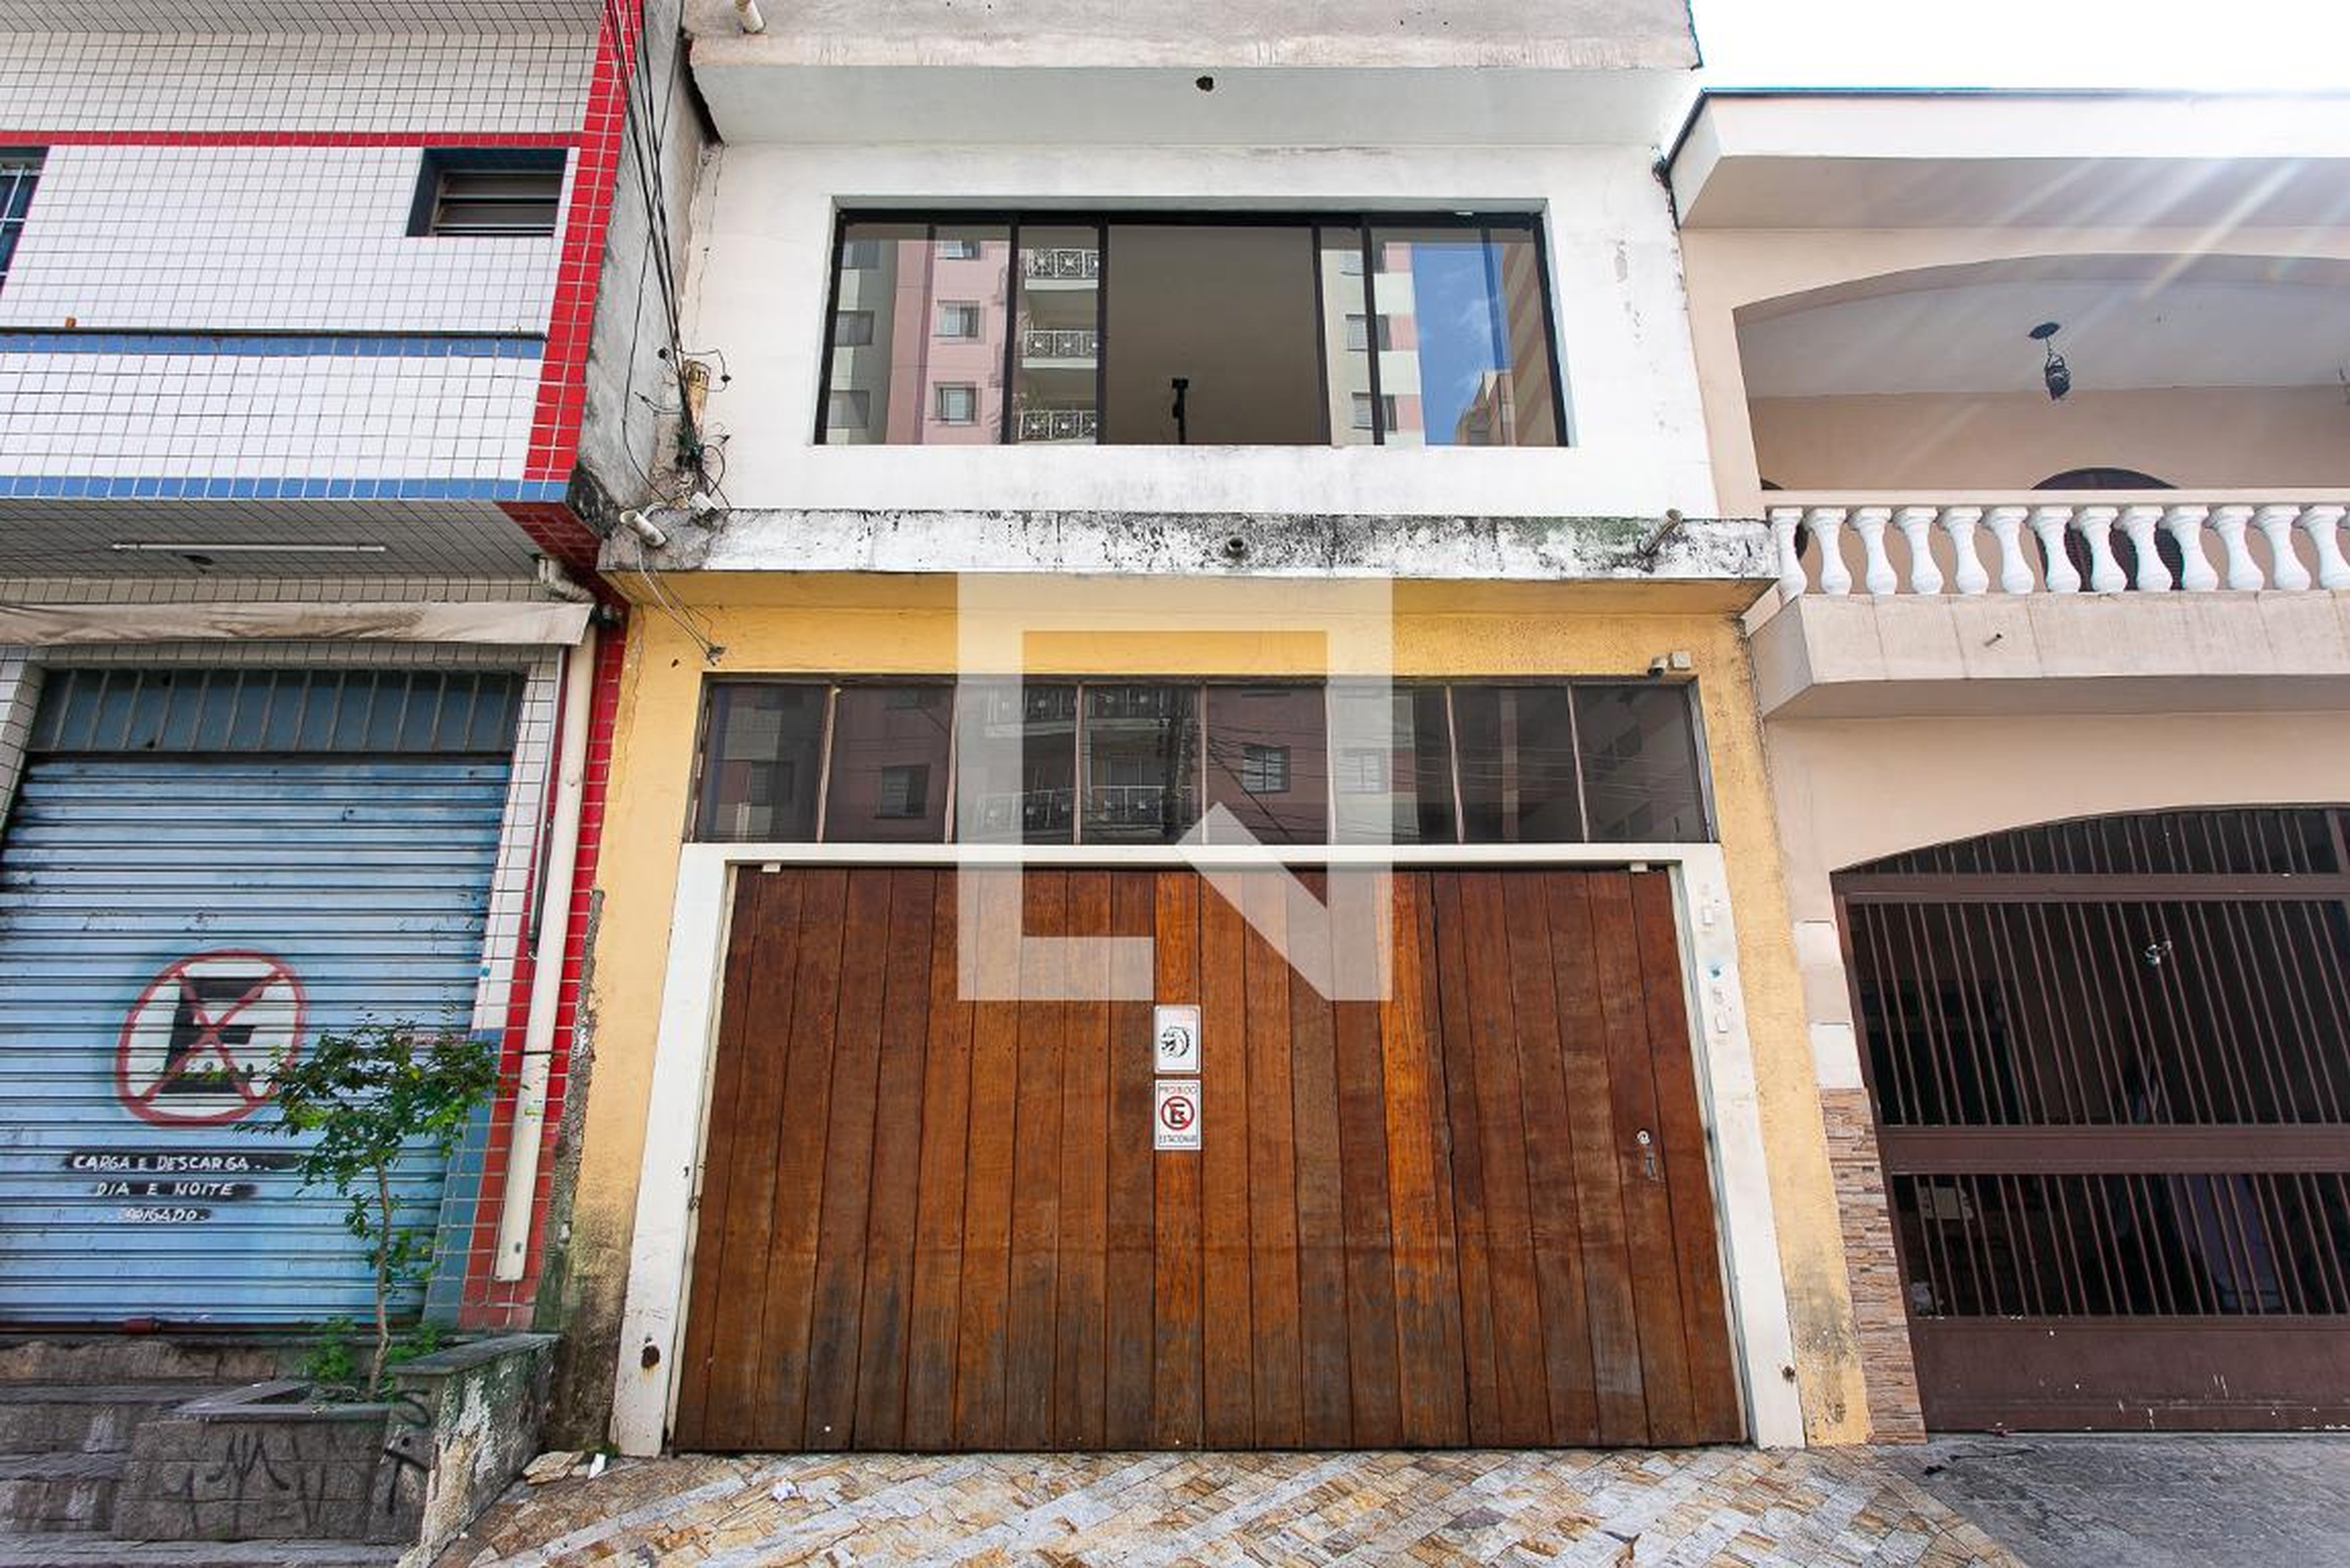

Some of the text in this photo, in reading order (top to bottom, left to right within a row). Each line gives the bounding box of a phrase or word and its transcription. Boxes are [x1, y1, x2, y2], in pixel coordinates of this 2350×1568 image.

[72, 1155, 130, 1171] CARGA
[95, 1182, 235, 1195] DIA E NOITE
